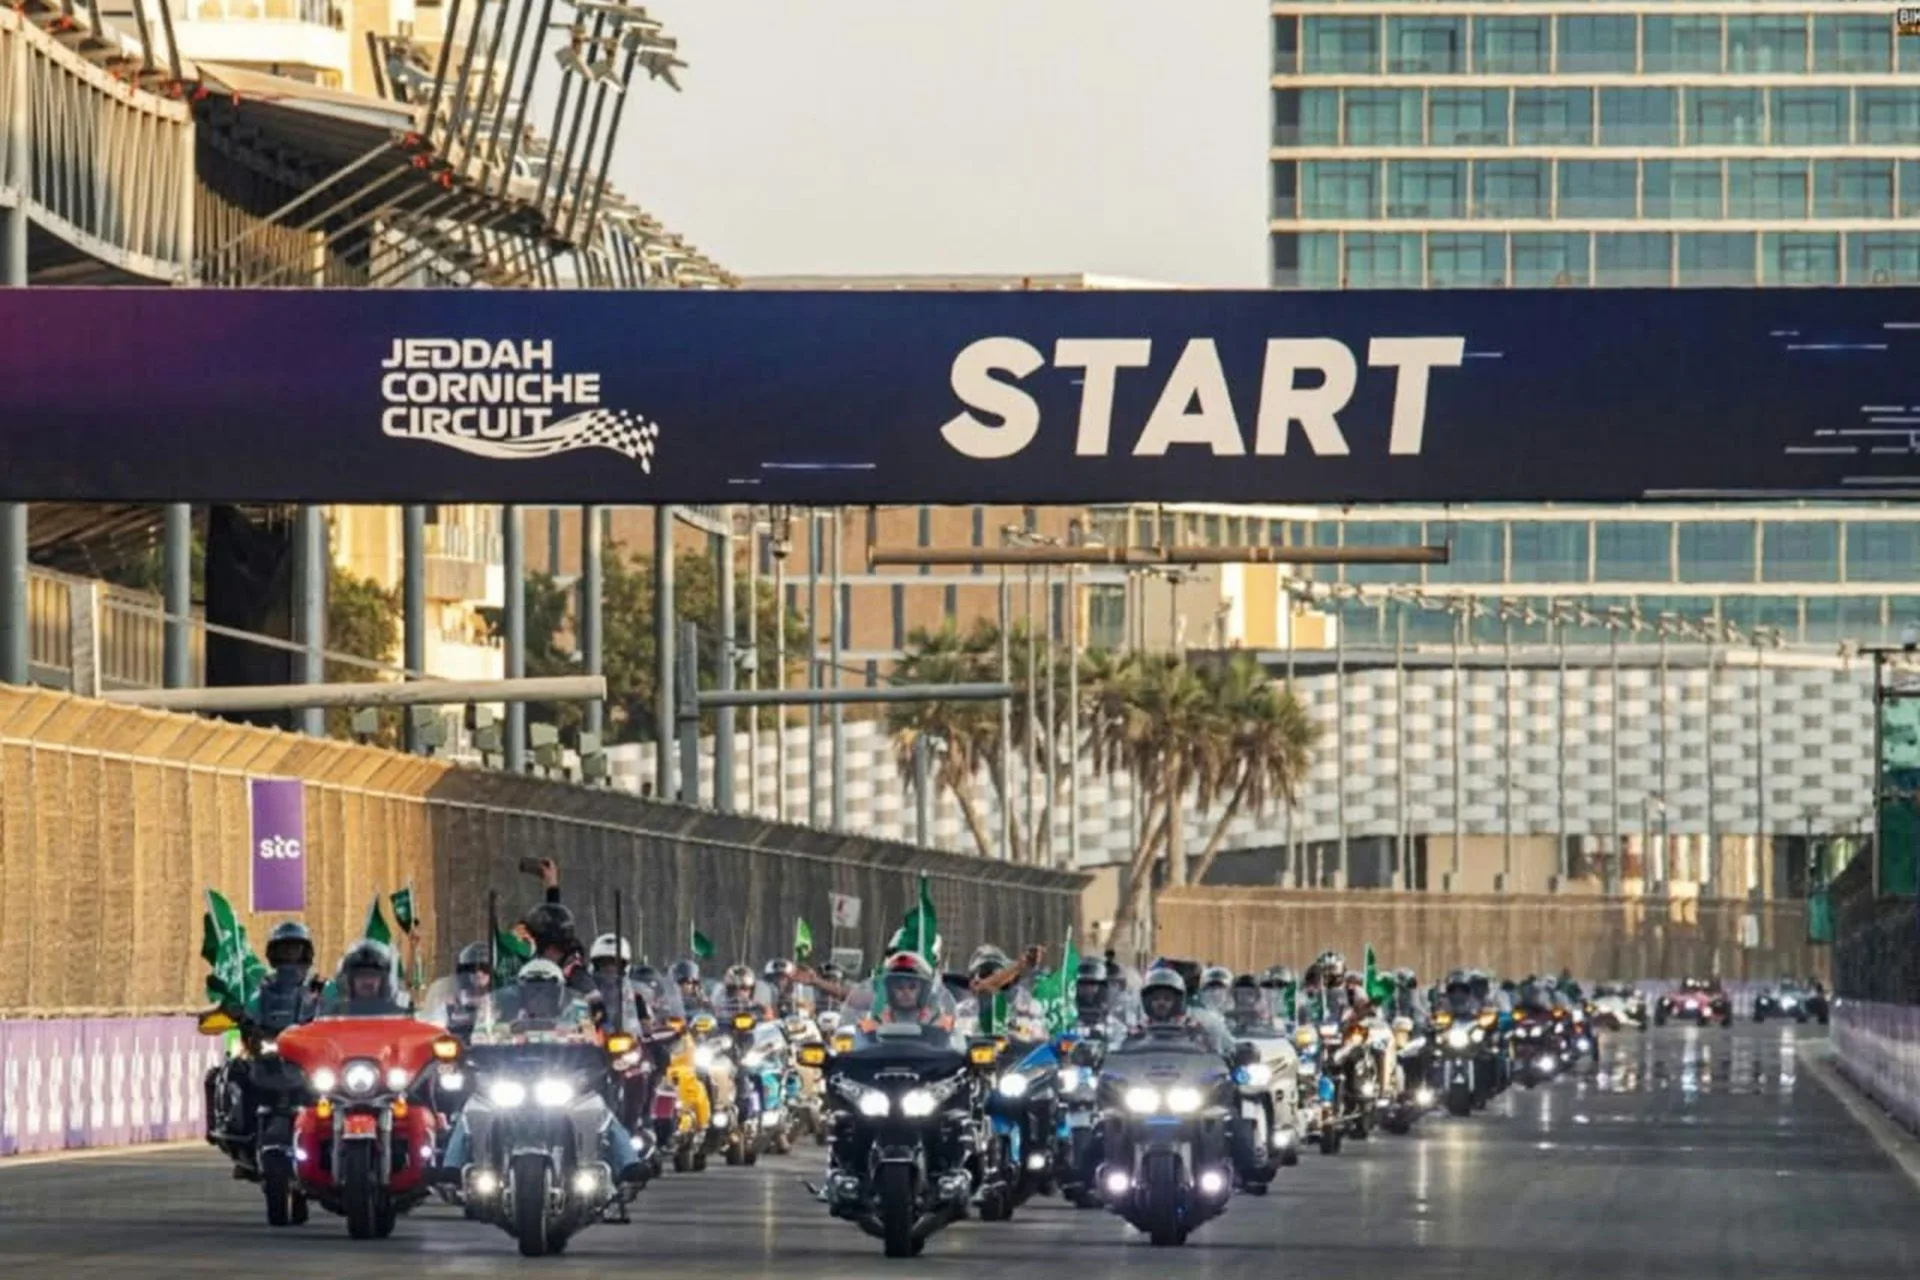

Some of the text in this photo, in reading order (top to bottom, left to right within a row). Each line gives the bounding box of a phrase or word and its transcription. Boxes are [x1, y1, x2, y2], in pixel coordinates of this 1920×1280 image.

[382, 338, 552, 369] JEDDAH
[382, 373, 600, 403] CORNICHE
[940, 336, 1466, 459] START
[382, 407, 552, 437] CIRCUIT
[260, 835, 301, 859] stc
